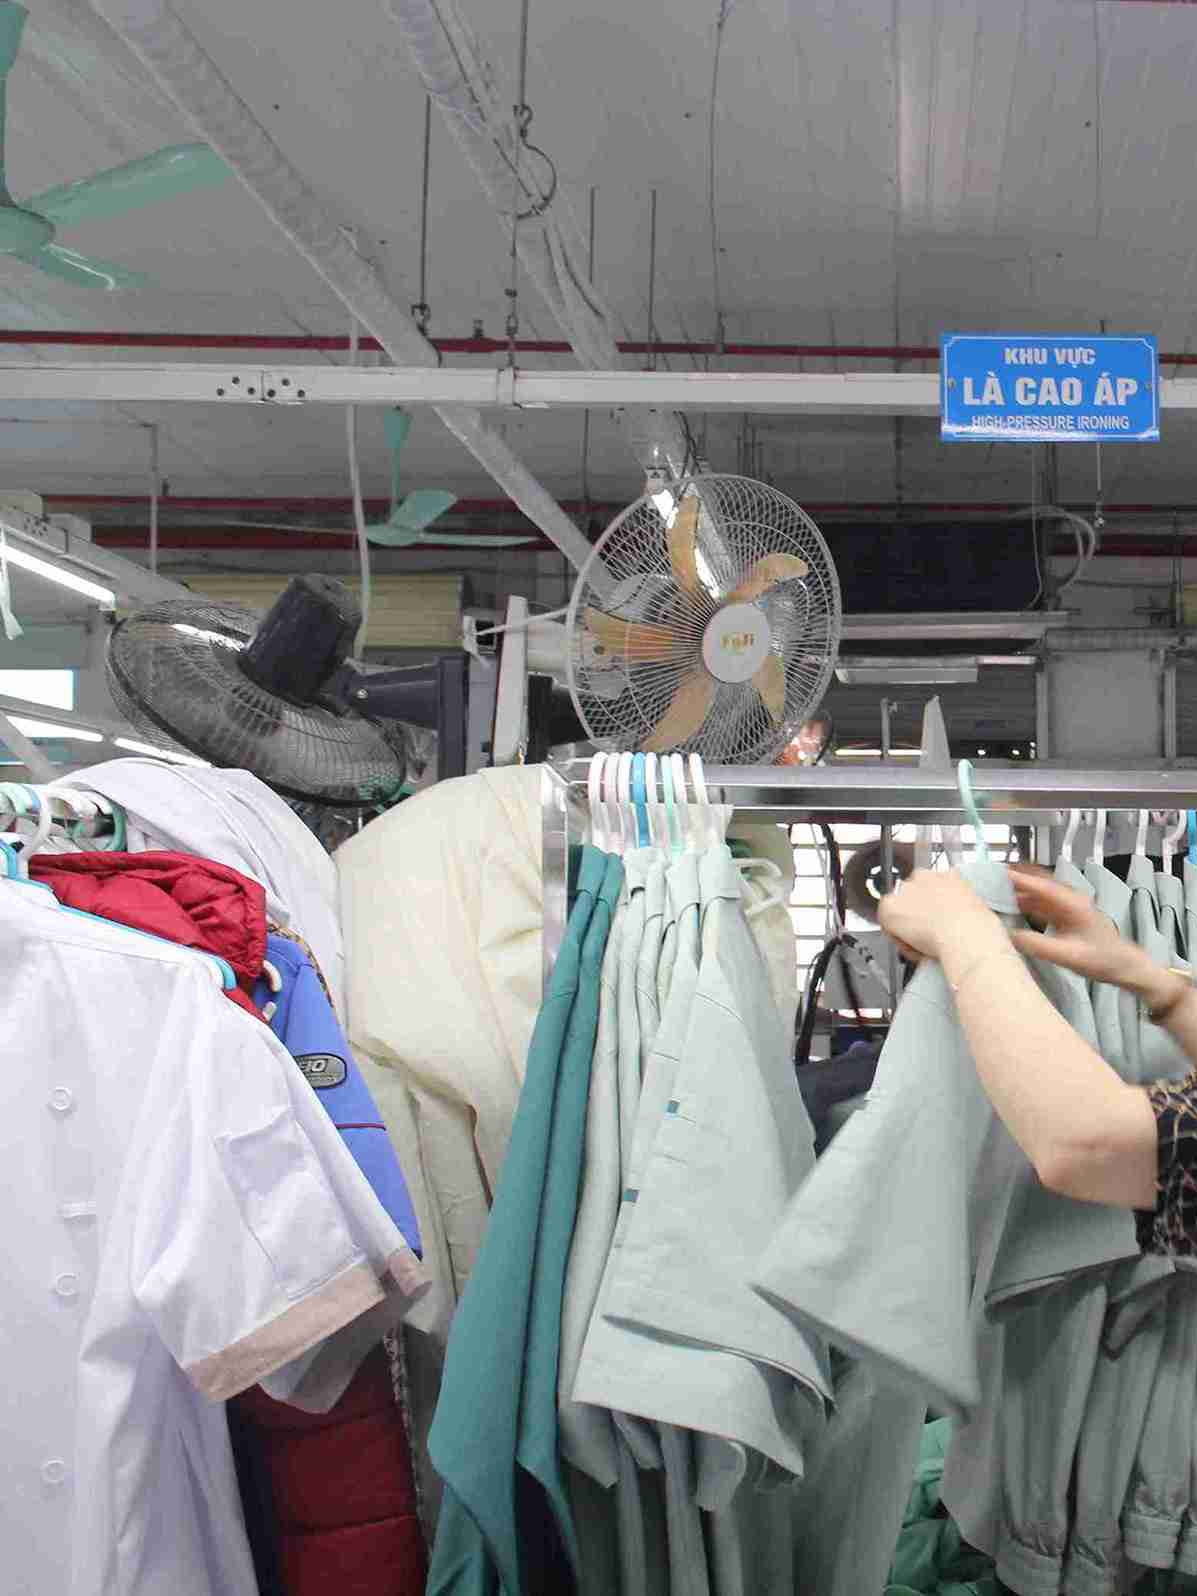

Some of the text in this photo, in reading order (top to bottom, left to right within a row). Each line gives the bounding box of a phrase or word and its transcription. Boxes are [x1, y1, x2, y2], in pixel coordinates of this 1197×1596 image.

[1004, 347, 1096, 368] KHU VỰC
[963, 371, 1138, 406] LÀ CAO ÁP
[1078, 416, 1129, 430] IRONING
